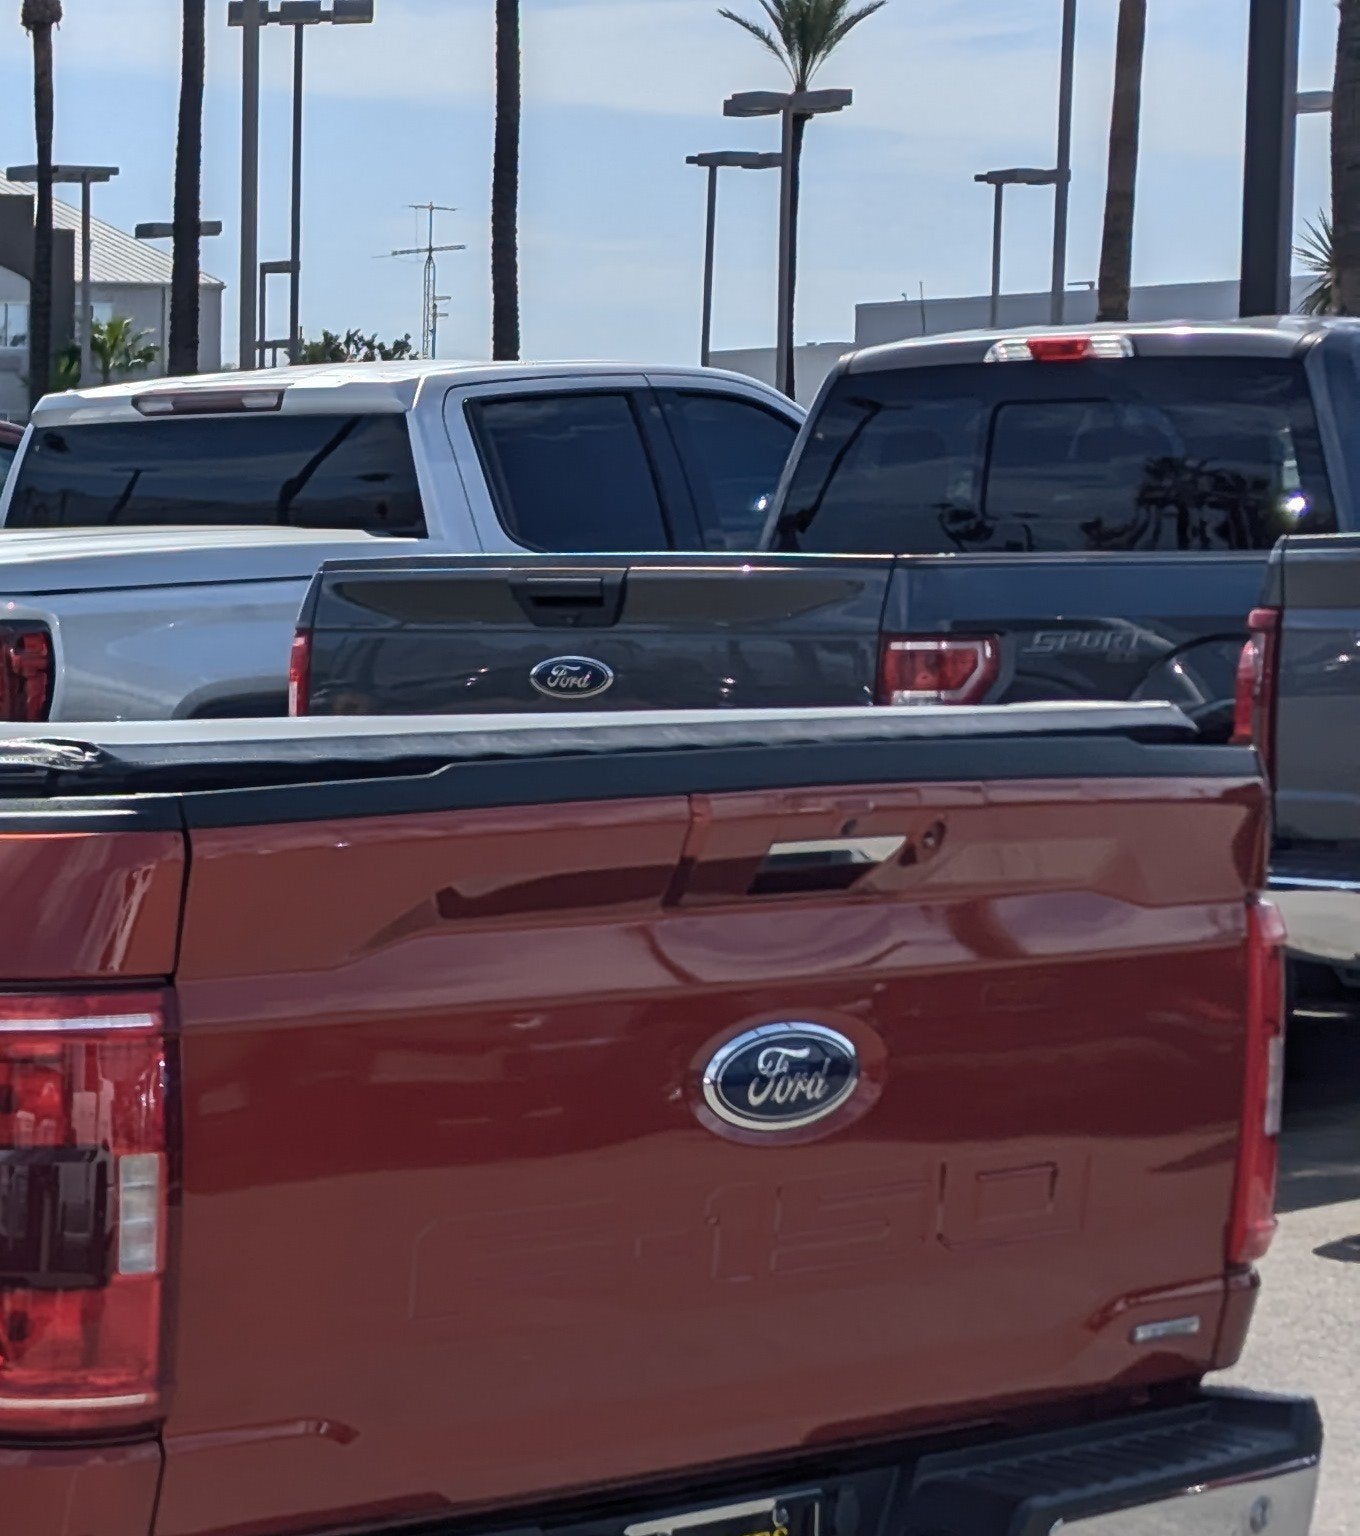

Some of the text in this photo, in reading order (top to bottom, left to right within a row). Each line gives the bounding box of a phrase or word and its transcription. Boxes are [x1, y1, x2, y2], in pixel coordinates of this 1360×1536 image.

[1022, 631, 1140, 653] SPORT
[547, 664, 592, 688] Ford
[747, 1046, 832, 1107] Ford
